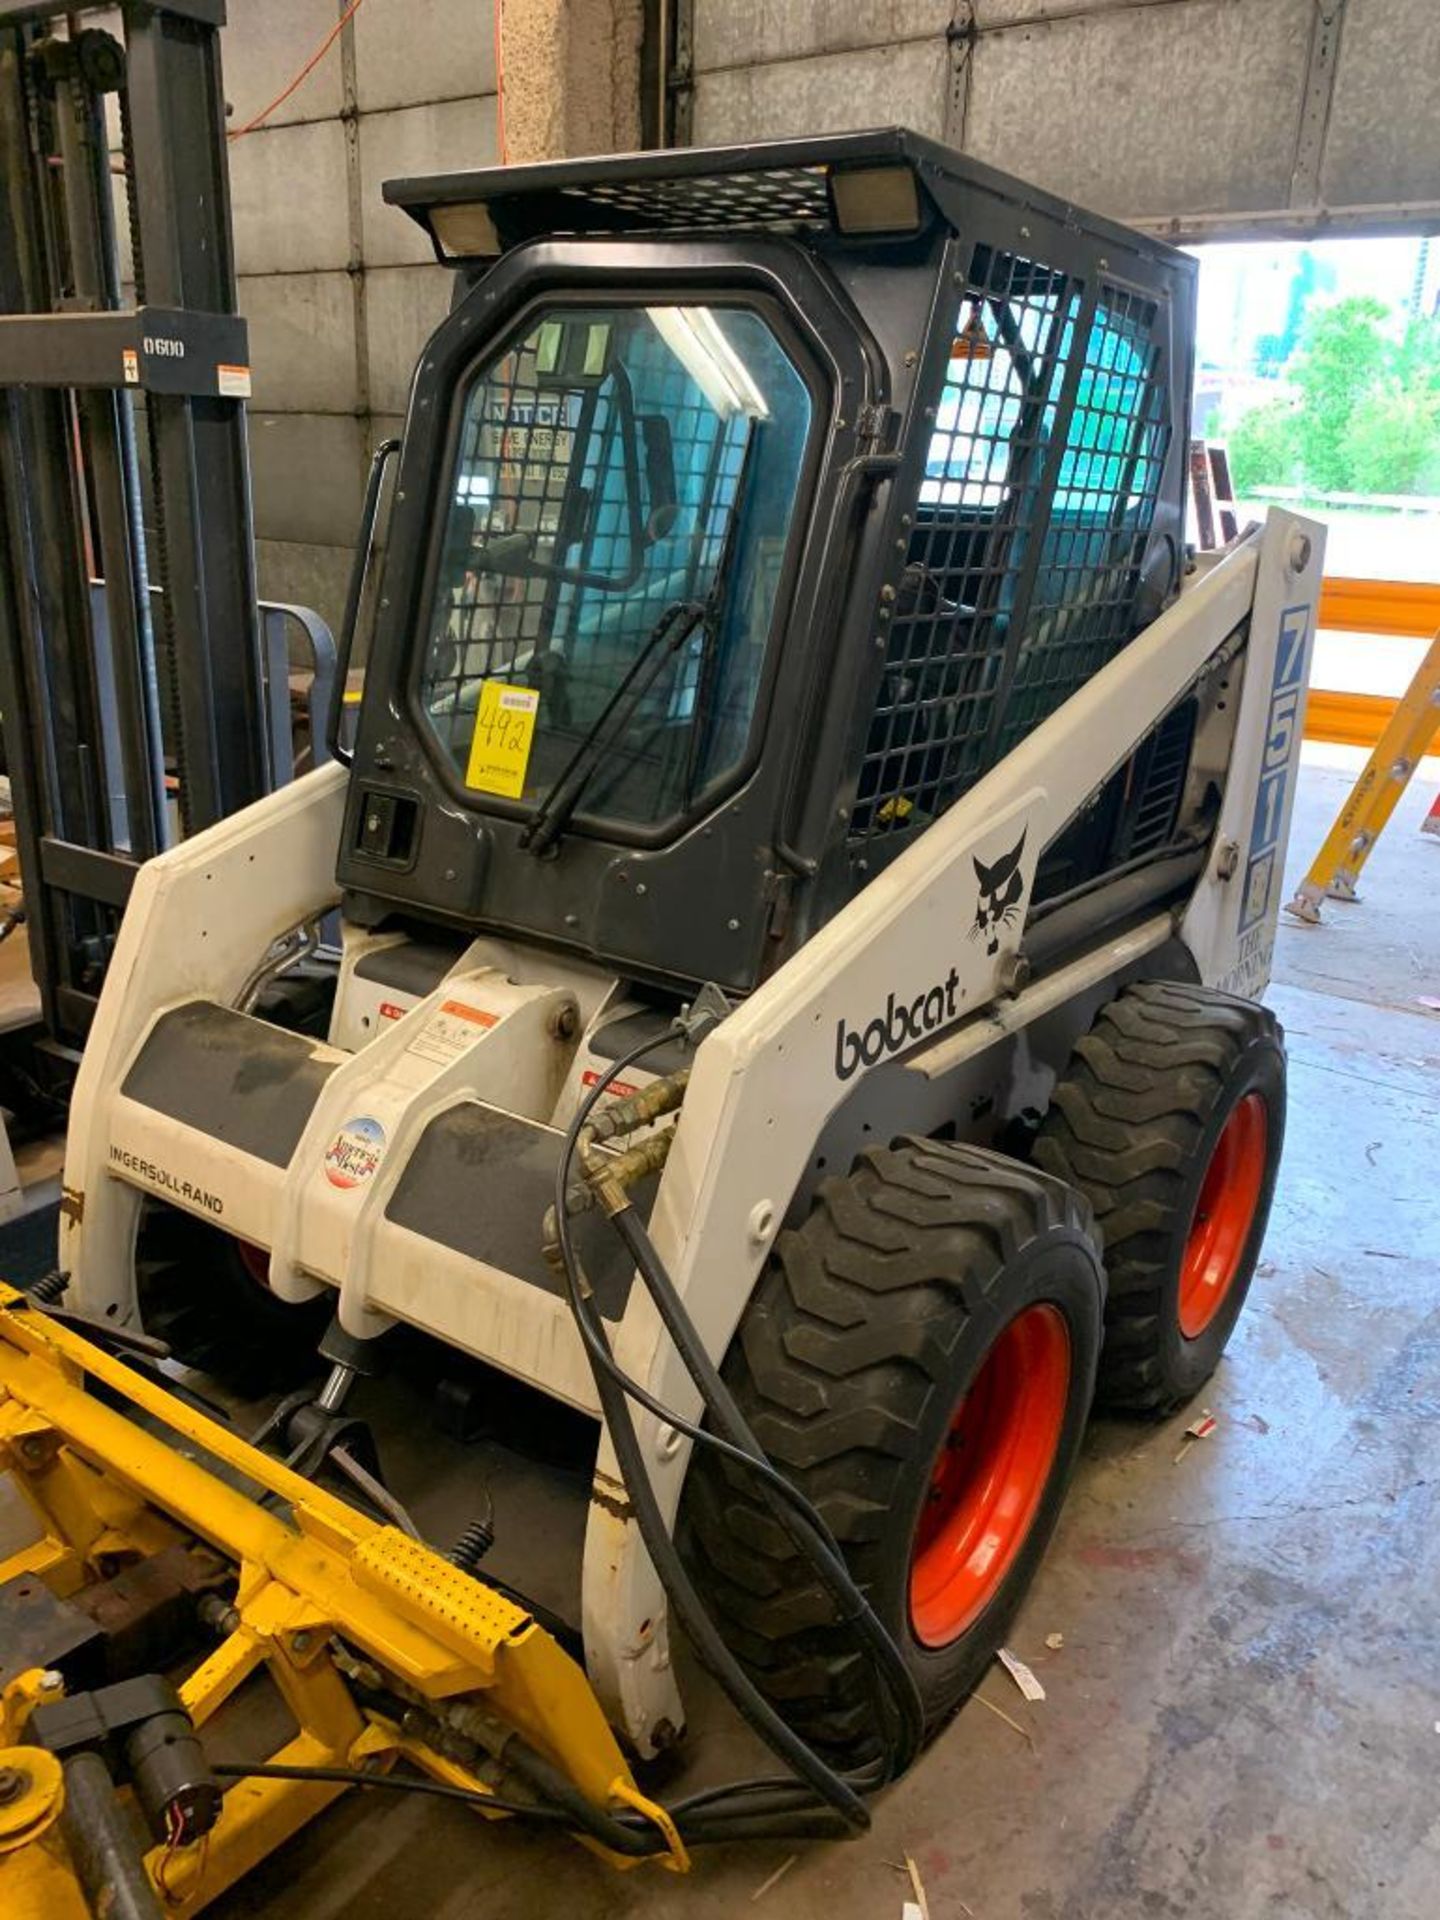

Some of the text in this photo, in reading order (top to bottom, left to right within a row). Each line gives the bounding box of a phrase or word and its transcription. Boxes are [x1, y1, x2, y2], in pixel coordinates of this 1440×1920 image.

[492, 403, 567, 427] NOTCE
[480, 704, 527, 752] 492
[834, 967, 960, 1081] bobcat
[109, 1144, 224, 1215] INGERSOLL-RAND
